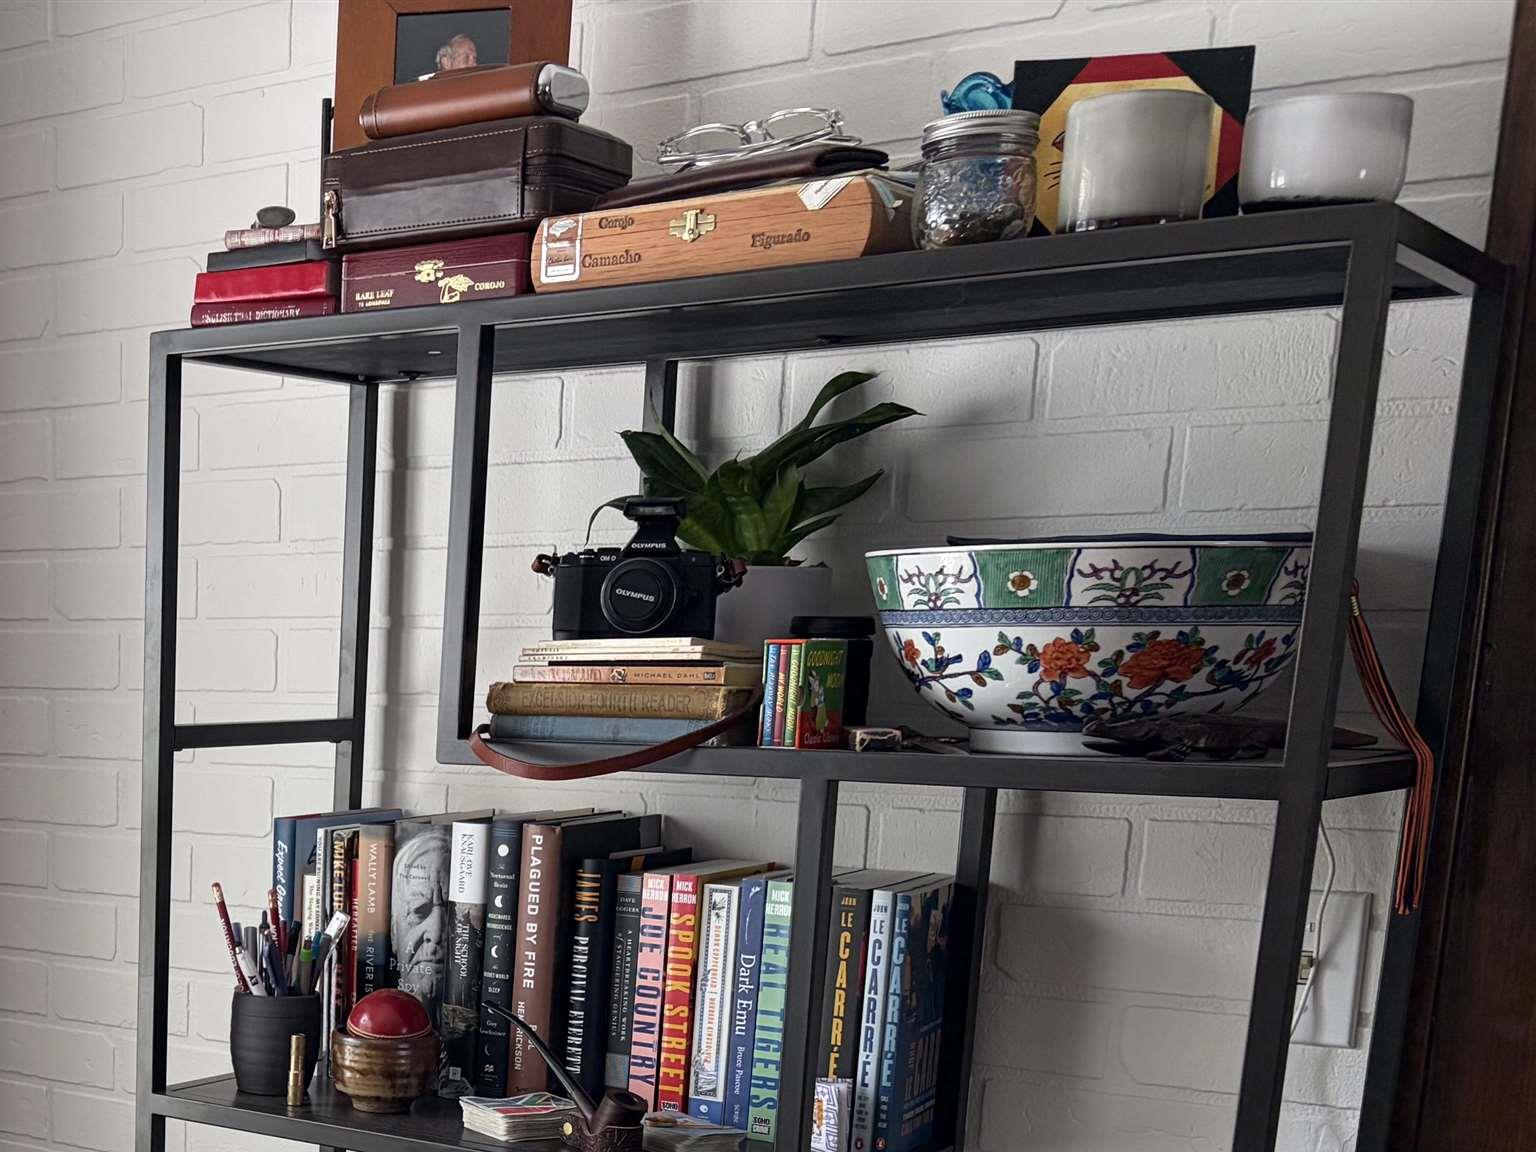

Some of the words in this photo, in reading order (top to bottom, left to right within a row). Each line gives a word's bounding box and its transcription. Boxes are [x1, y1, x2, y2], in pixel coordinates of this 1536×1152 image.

[598, 215, 635, 231] Corojo
[750, 228, 811, 250] Figurado
[581, 249, 642, 269] Camacho
[375, 289, 394, 300] LEAF
[474, 280, 505, 292] COROJO
[615, 588, 655, 602] OLYMPUS
[633, 672, 673, 680] MICHAEL
[275, 839, 288, 882] Expect
[366, 841, 378, 880] WALLY
[526, 834, 544, 917] PLAGUED
[366, 881, 377, 914] LAMB
[574, 869, 602, 924] JAMES
[872, 903, 889, 914] JOHN
[525, 921, 538, 946] BY
[639, 906, 666, 954] JOE
[840, 911, 853, 928] LE
[872, 919, 886, 935] LE
[894, 917, 909, 934] LE
[389, 957, 433, 976] Private
[522, 950, 536, 990] FIRE
[569, 935, 590, 1004] PERCIVAL
[664, 911, 696, 995] SPOOK
[760, 923, 790, 992] REAL
[738, 953, 756, 994] Dark
[628, 967, 661, 1088] COUNTRY
[735, 999, 752, 1037] Emu
[859, 938, 882, 1088] CARRÉ
[881, 936, 904, 1088] CARRÉ
[514, 1001, 525, 1072] HENRICKSON
[564, 1009, 585, 1075] EVERETT
[658, 1002, 689, 1097] STREET
[750, 1007, 785, 1110] TIGERS
